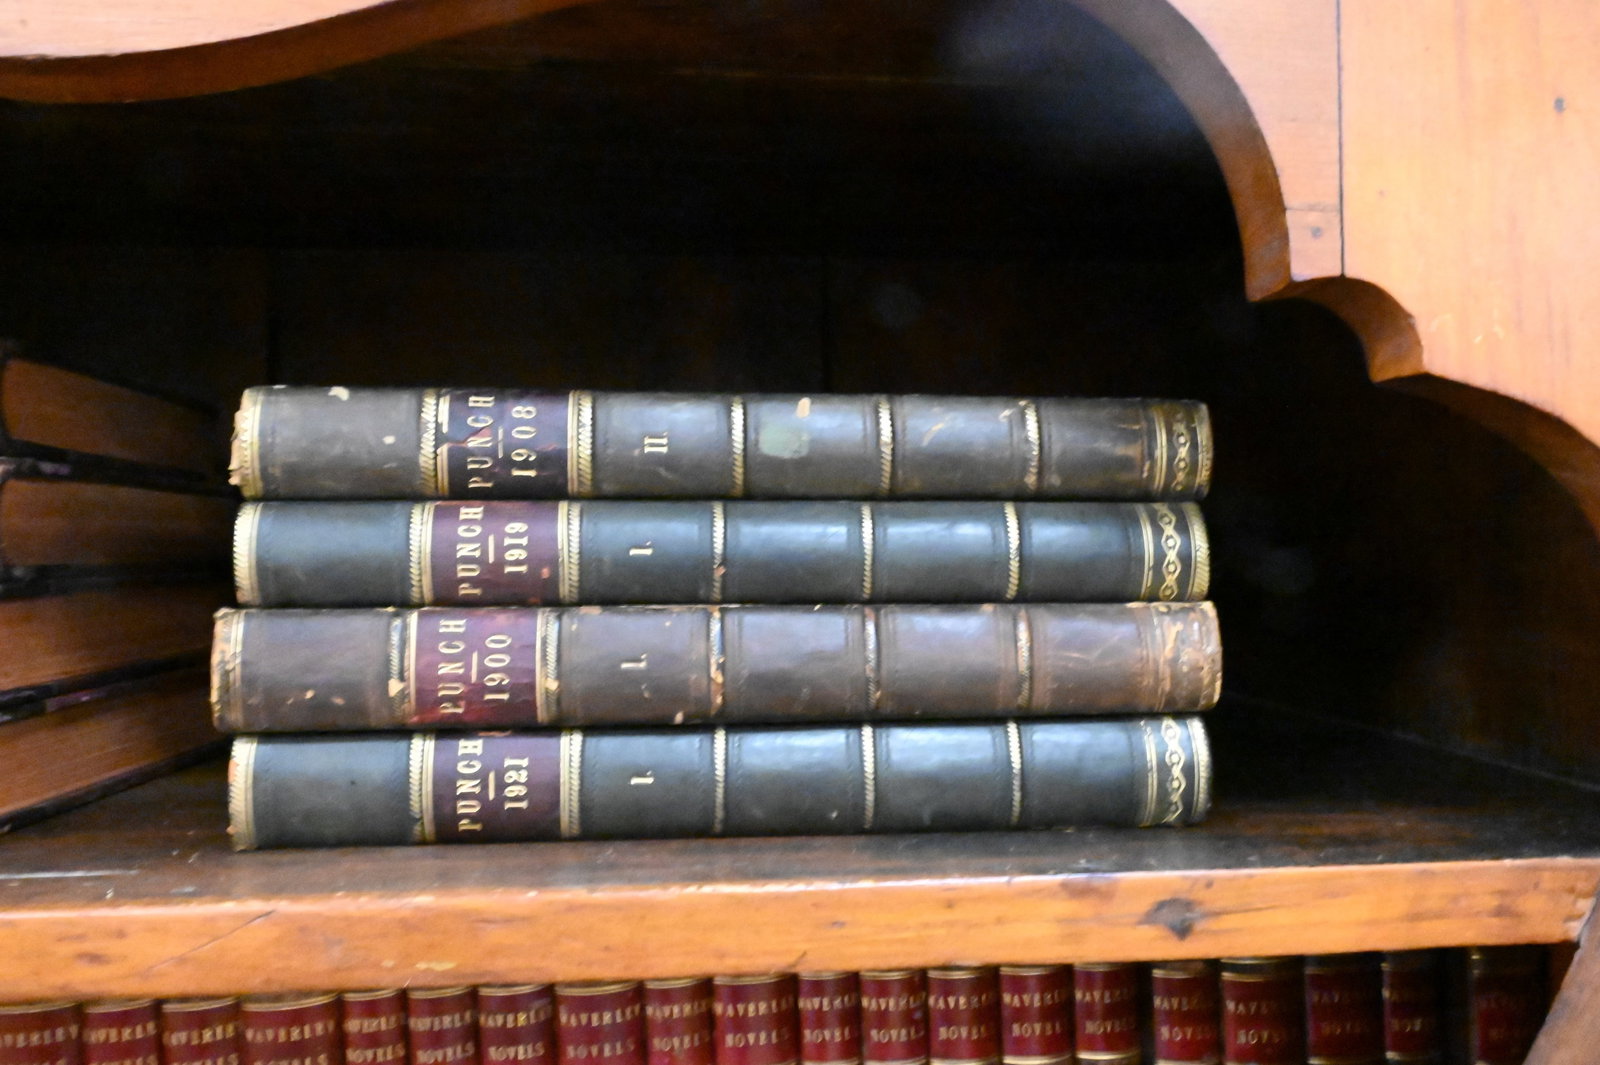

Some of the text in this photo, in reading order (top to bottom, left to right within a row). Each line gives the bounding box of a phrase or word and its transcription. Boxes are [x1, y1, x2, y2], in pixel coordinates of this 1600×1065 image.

[467, 395, 495, 488] PUNCH
[511, 405, 537, 477] 1908
[456, 505, 484, 596] PUNCH
[503, 522, 529, 574] 1919
[437, 618, 467, 714] PUNCH
[483, 634, 512, 701] 1900
[456, 738, 484, 832] PUNCH
[503, 756, 529, 810] 1921
